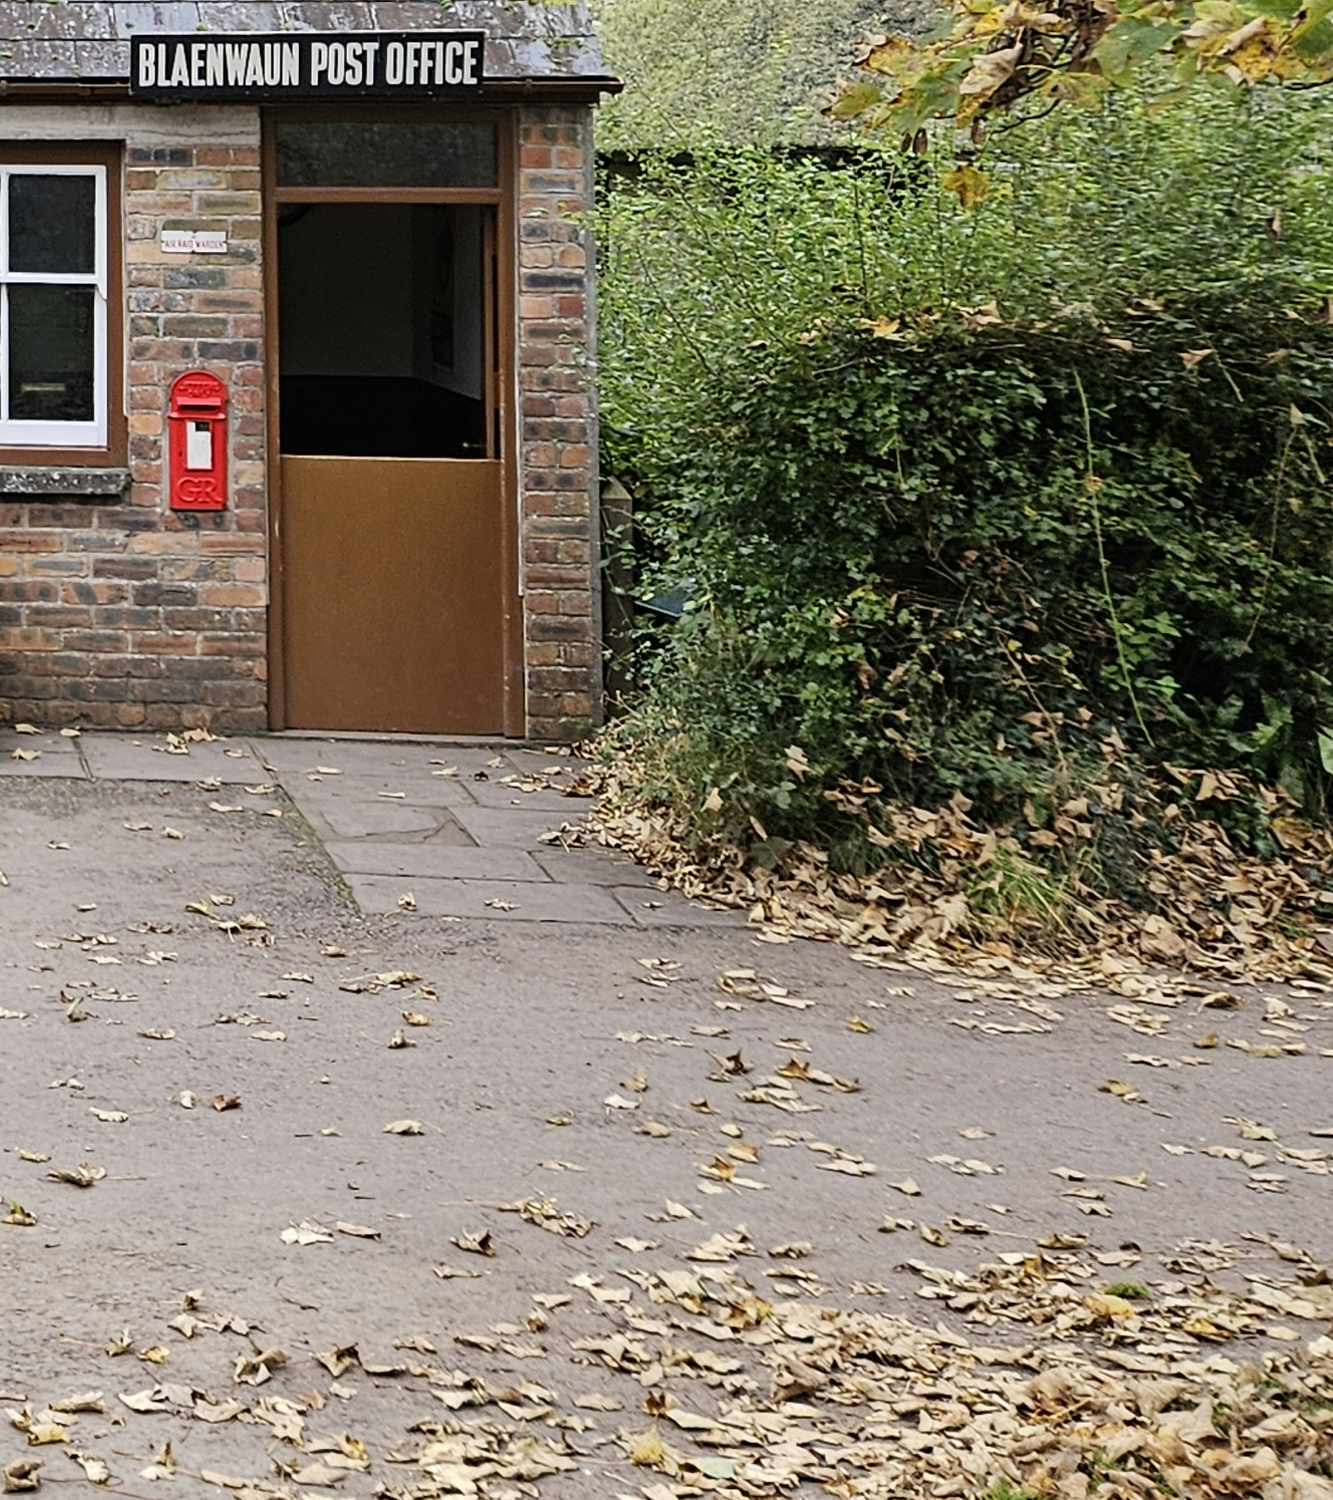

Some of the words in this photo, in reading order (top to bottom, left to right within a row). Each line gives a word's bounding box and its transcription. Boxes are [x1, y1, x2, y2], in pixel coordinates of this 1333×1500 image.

[138, 43, 299, 87] BLAENWAUN
[311, 42, 379, 86] POST
[386, 41, 479, 85] OFFICE
[176, 476, 223, 503] GR
